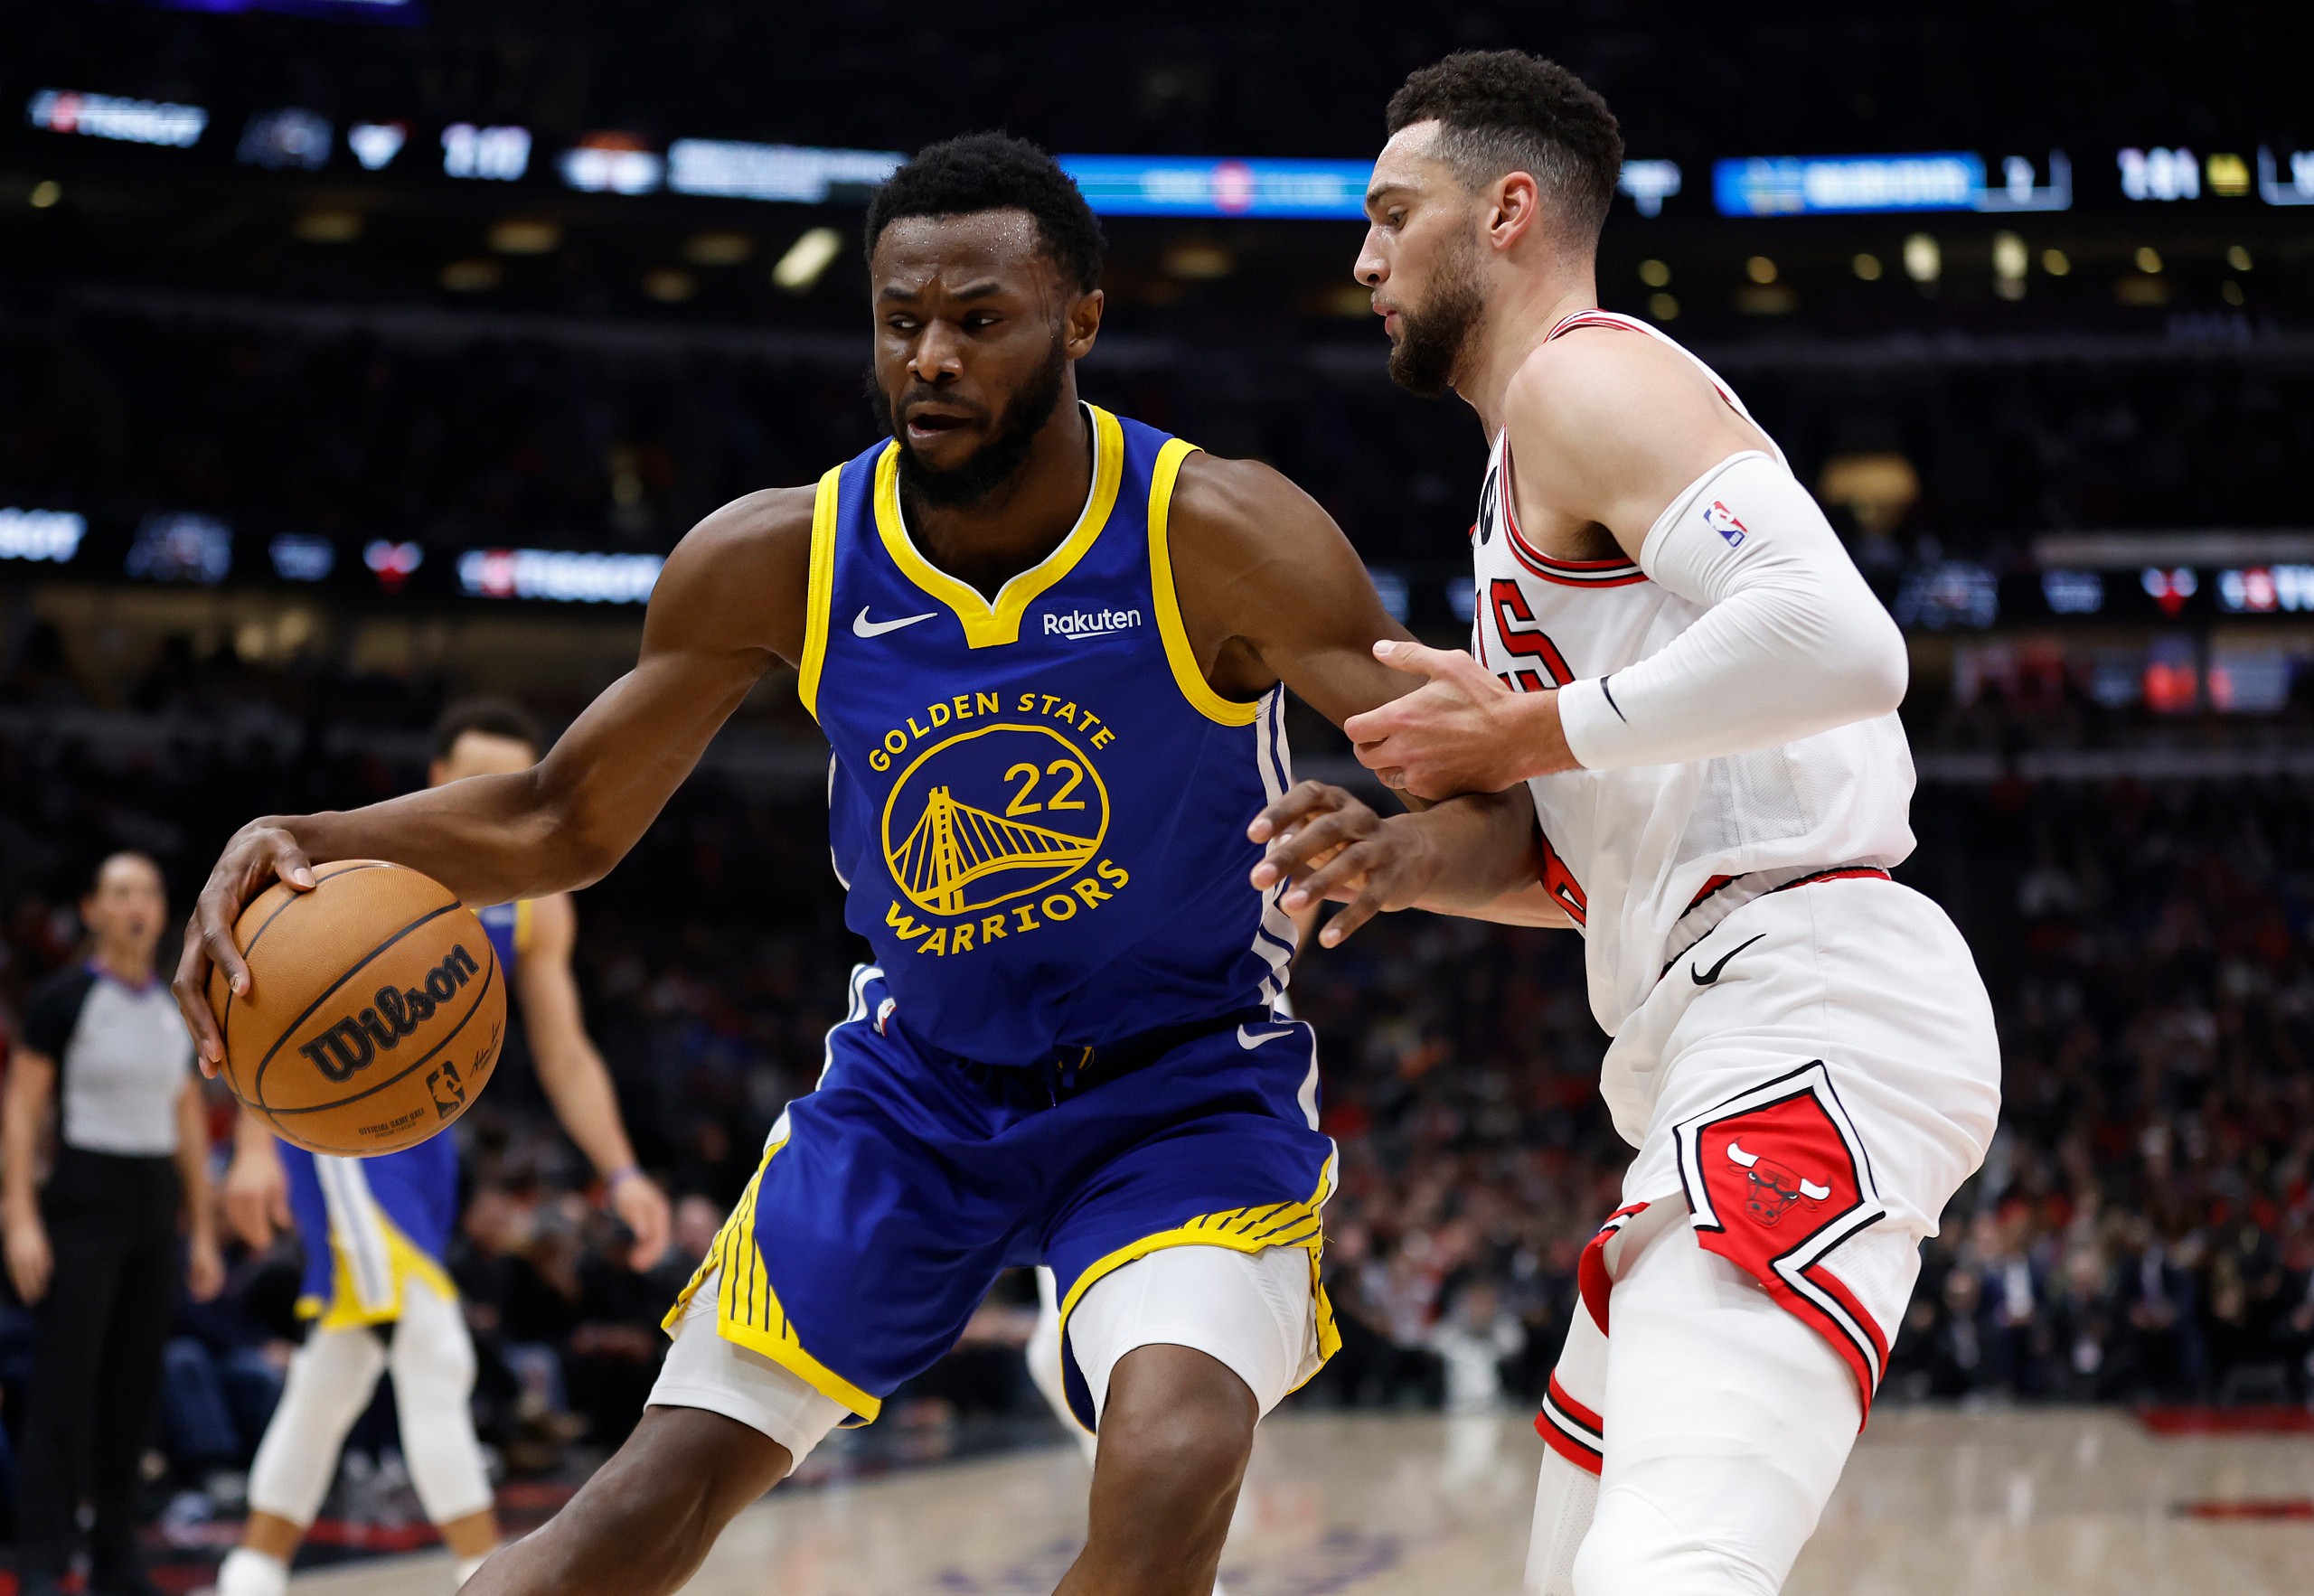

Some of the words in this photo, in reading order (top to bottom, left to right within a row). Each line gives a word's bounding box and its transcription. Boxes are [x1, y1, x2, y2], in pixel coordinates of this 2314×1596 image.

[1043, 608, 1142, 635] Rakuten
[869, 692, 1000, 772] GOLDEN
[1017, 692, 1116, 750] STATE
[1003, 759, 1086, 817] 22
[883, 858, 1130, 958] WARRIORS
[297, 944, 479, 1084] Wilson
[358, 1122, 390, 1136] OFFICIAL
[390, 1115, 409, 1129] GAME
[409, 1106, 426, 1121] BALL
